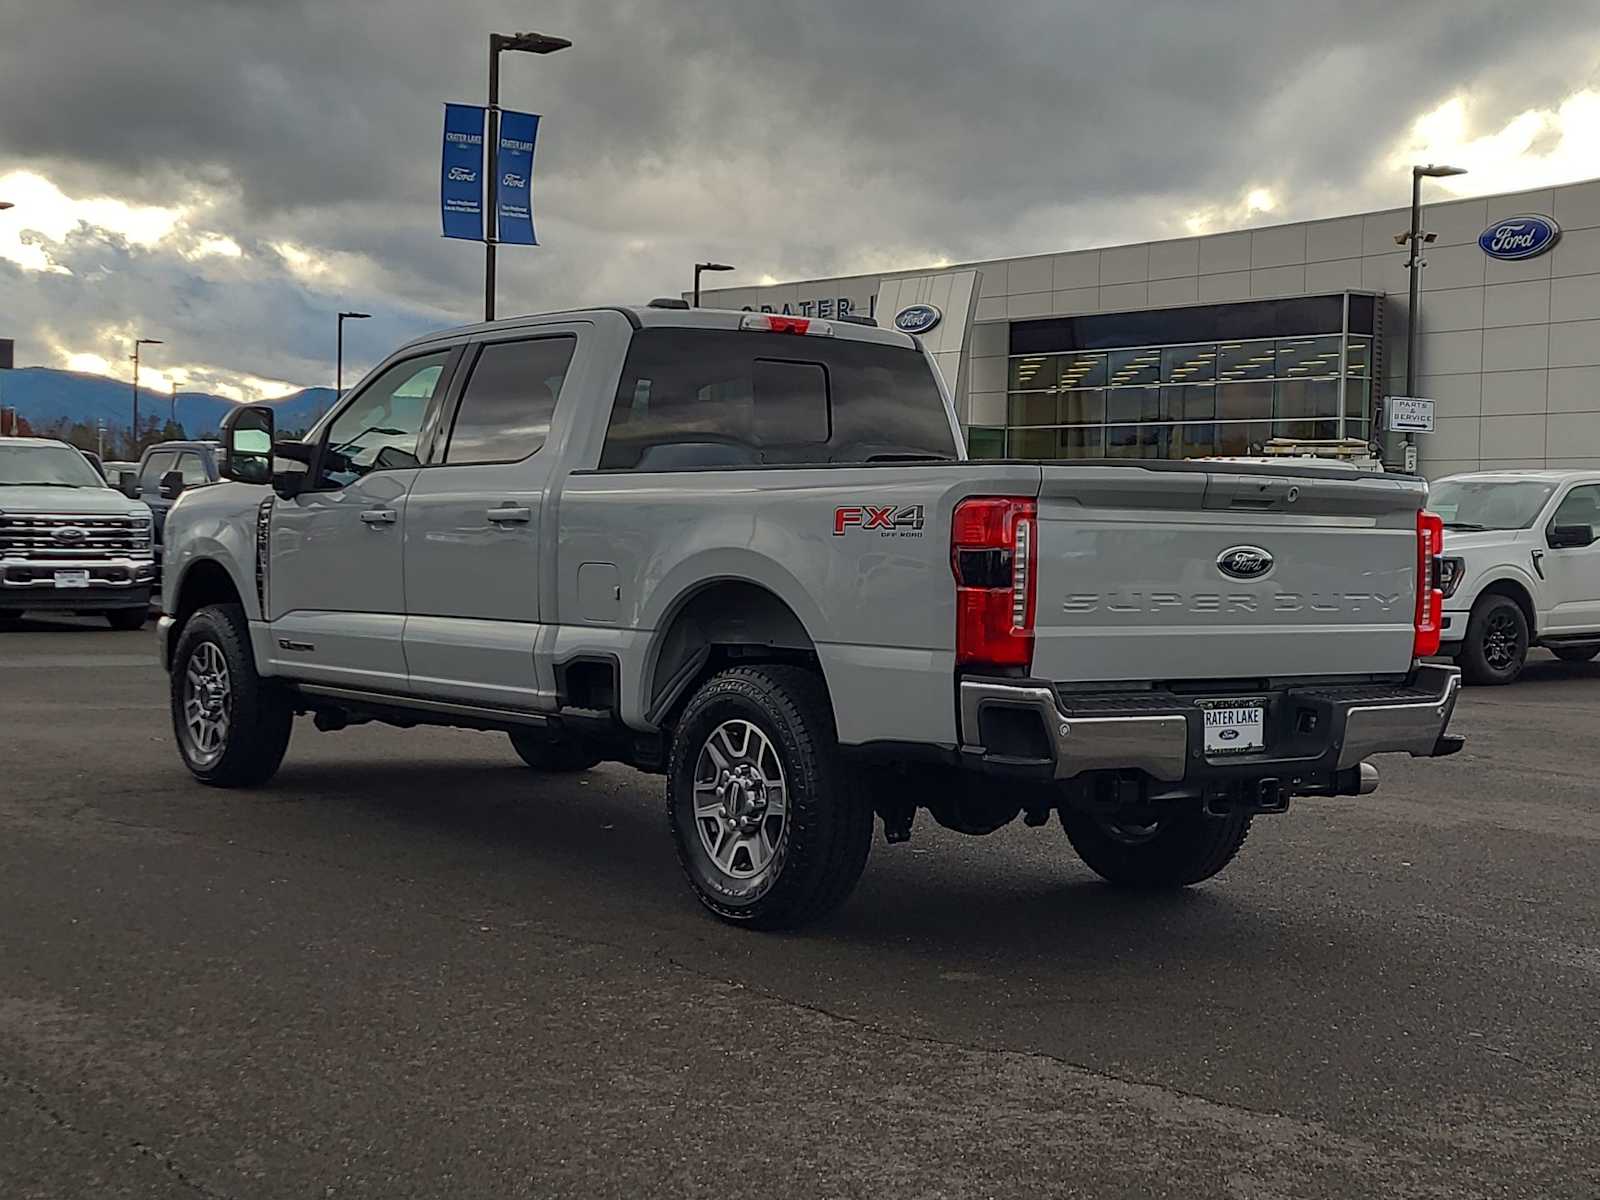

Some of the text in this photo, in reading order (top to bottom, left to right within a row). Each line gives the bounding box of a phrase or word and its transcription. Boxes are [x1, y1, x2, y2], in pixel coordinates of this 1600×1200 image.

[448, 167, 476, 182] Ford
[502, 173, 526, 188] Ford
[1491, 224, 1536, 251] Ford
[742, 298, 850, 319] ATER
[901, 310, 928, 326] Ford
[1400, 401, 1427, 409] PARTS
[1394, 413, 1432, 421] SERVICE
[832, 504, 925, 536] FX4
[1232, 552, 1263, 570] Ford
[1063, 593, 1400, 612] SUPER DUTY
[1205, 709, 1259, 725] RATER LAKE
